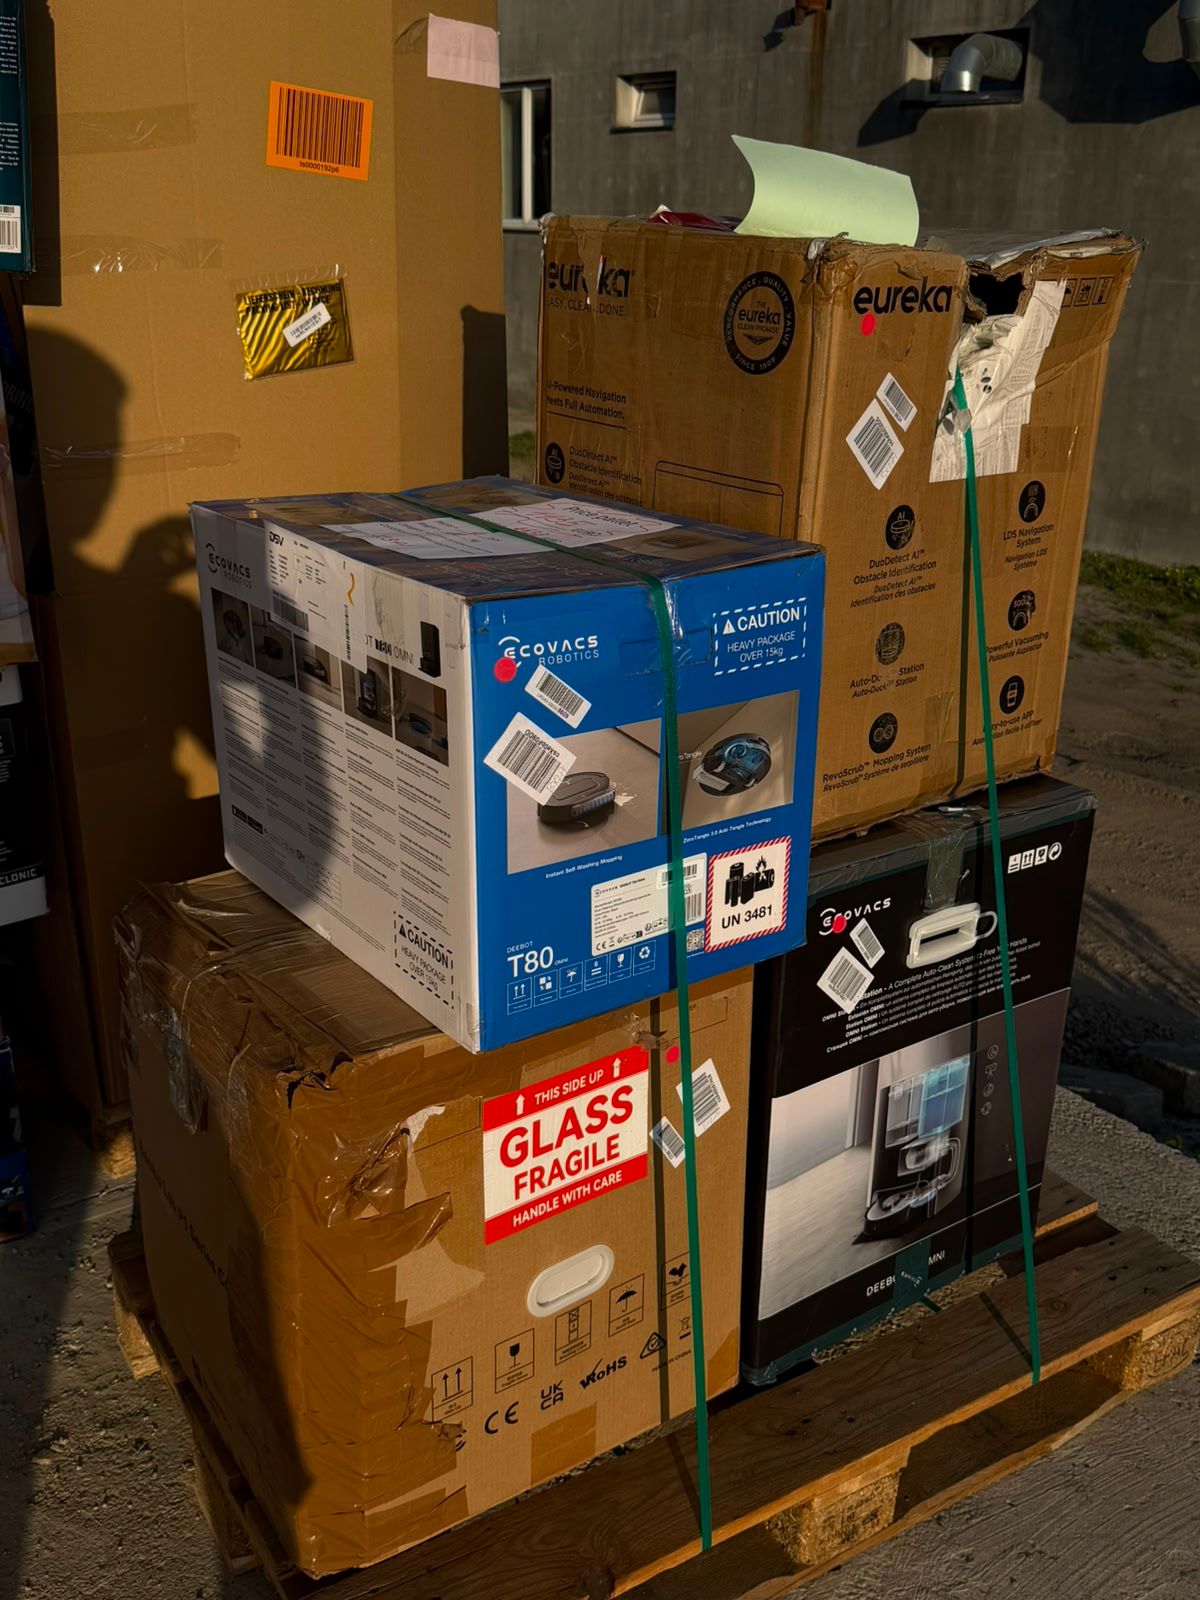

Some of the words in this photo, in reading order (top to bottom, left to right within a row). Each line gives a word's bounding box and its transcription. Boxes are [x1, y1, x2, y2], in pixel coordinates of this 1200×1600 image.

[853, 276, 953, 315] eureka
[738, 307, 781, 326] eureka
[1003, 529, 1017, 541] LDS
[1018, 523, 1054, 538] Navigation
[853, 571, 888, 585] Obstacle
[888, 560, 937, 578] Identification
[869, 553, 910, 569] DuoDetect
[737, 606, 800, 632] CAUTION
[498, 635, 599, 669] ECOVACS
[727, 639, 756, 653] HEAVY
[756, 630, 797, 648] PACKAGE
[539, 649, 600, 666] ROBOTICS
[740, 649, 763, 663] OVER
[765, 647, 784, 657] 15kg
[898, 663, 925, 676] Station
[872, 752, 904, 768] Mopping
[905, 743, 932, 757] System
[721, 912, 741, 929] UN
[744, 904, 773, 923] 3481
[407, 929, 450, 970] CAUTION
[506, 941, 534, 953] DEEBOT
[507, 946, 554, 978] T80
[894, 973, 922, 989] Complete
[534, 1085, 561, 1106] THIS
[562, 1078, 586, 1095] SIDE
[588, 1069, 605, 1088] UP
[500, 1084, 634, 1168] GLASS
[514, 1133, 621, 1201] FRAGILE
[512, 1196, 559, 1228] HANDLE
[560, 1184, 591, 1206] WITH
[592, 1169, 623, 1190] CARE
[928, 1249, 946, 1267] MNI
